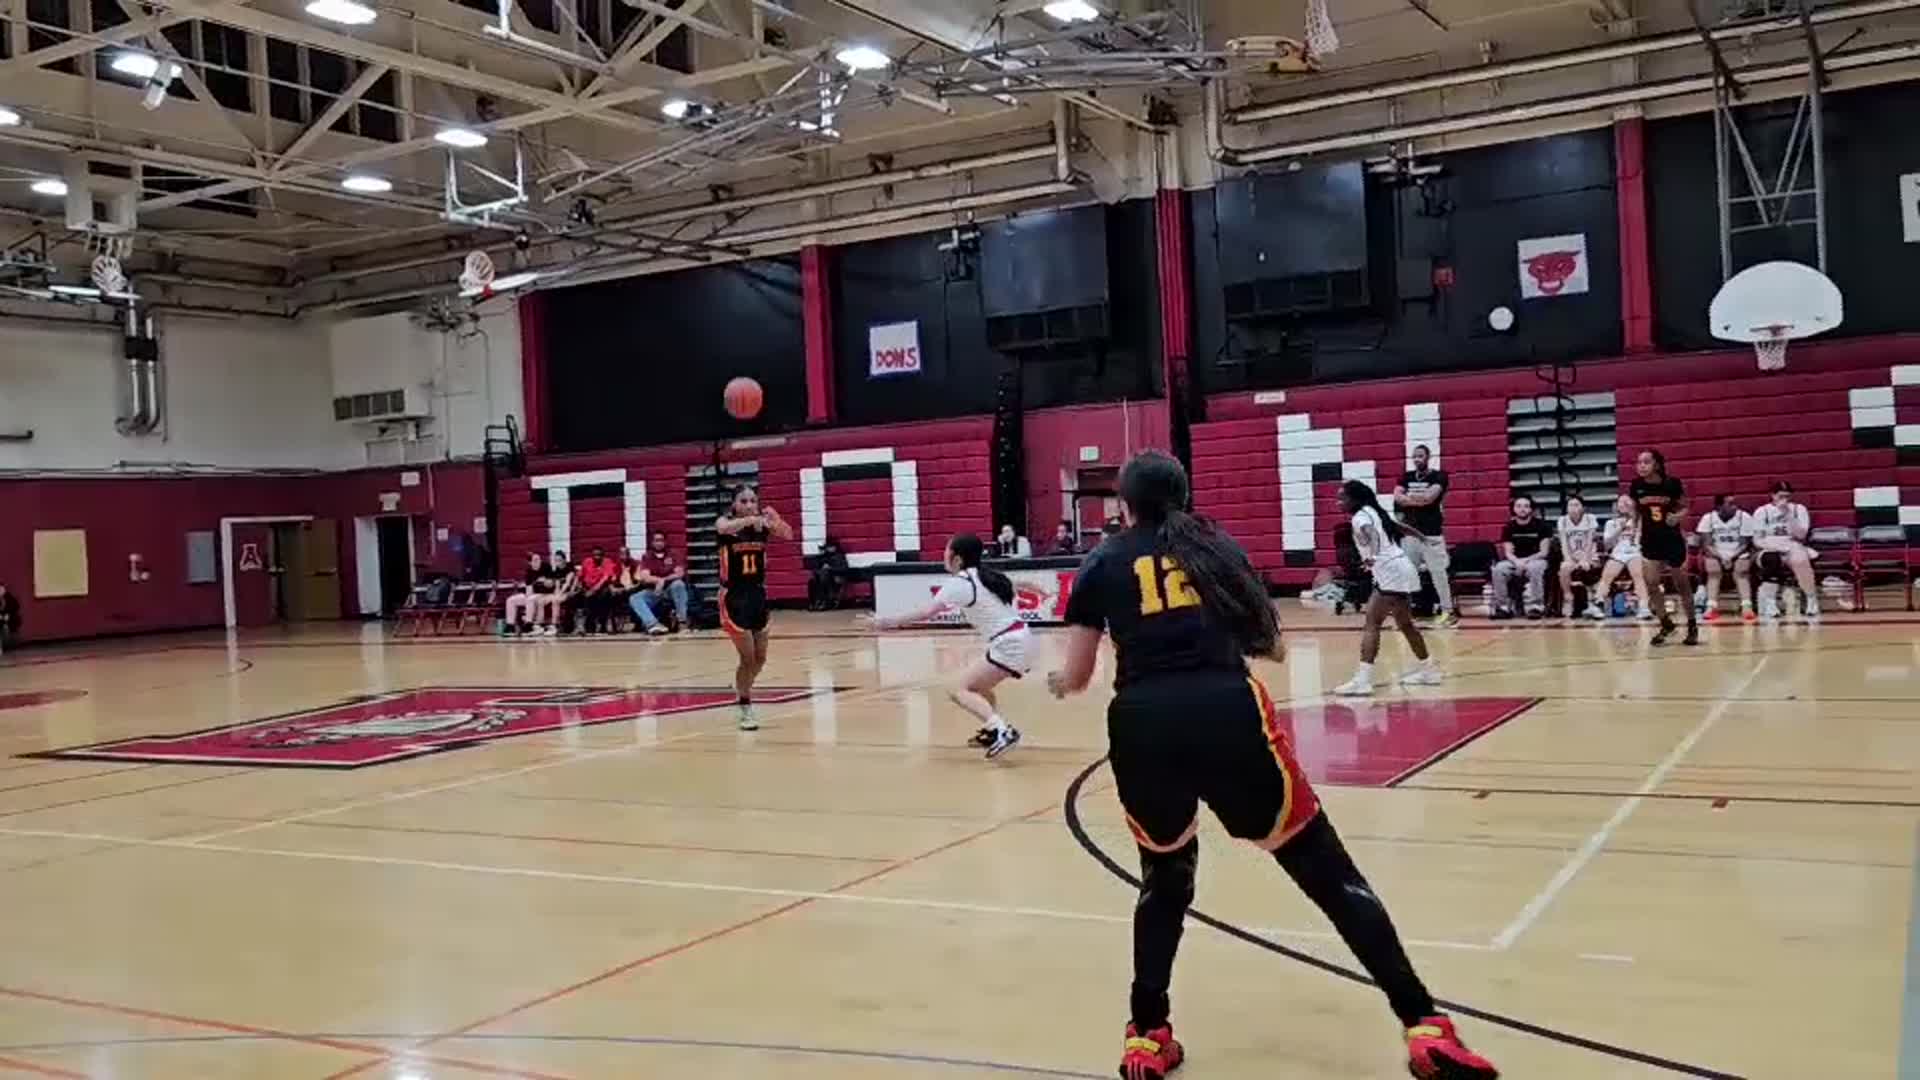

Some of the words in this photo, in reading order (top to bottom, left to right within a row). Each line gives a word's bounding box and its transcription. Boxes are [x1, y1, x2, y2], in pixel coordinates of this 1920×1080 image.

[876, 347, 917, 368] DONS
[1650, 506, 1662, 521] 5
[742, 554, 757, 574] 11
[1134, 555, 1202, 615] 12
